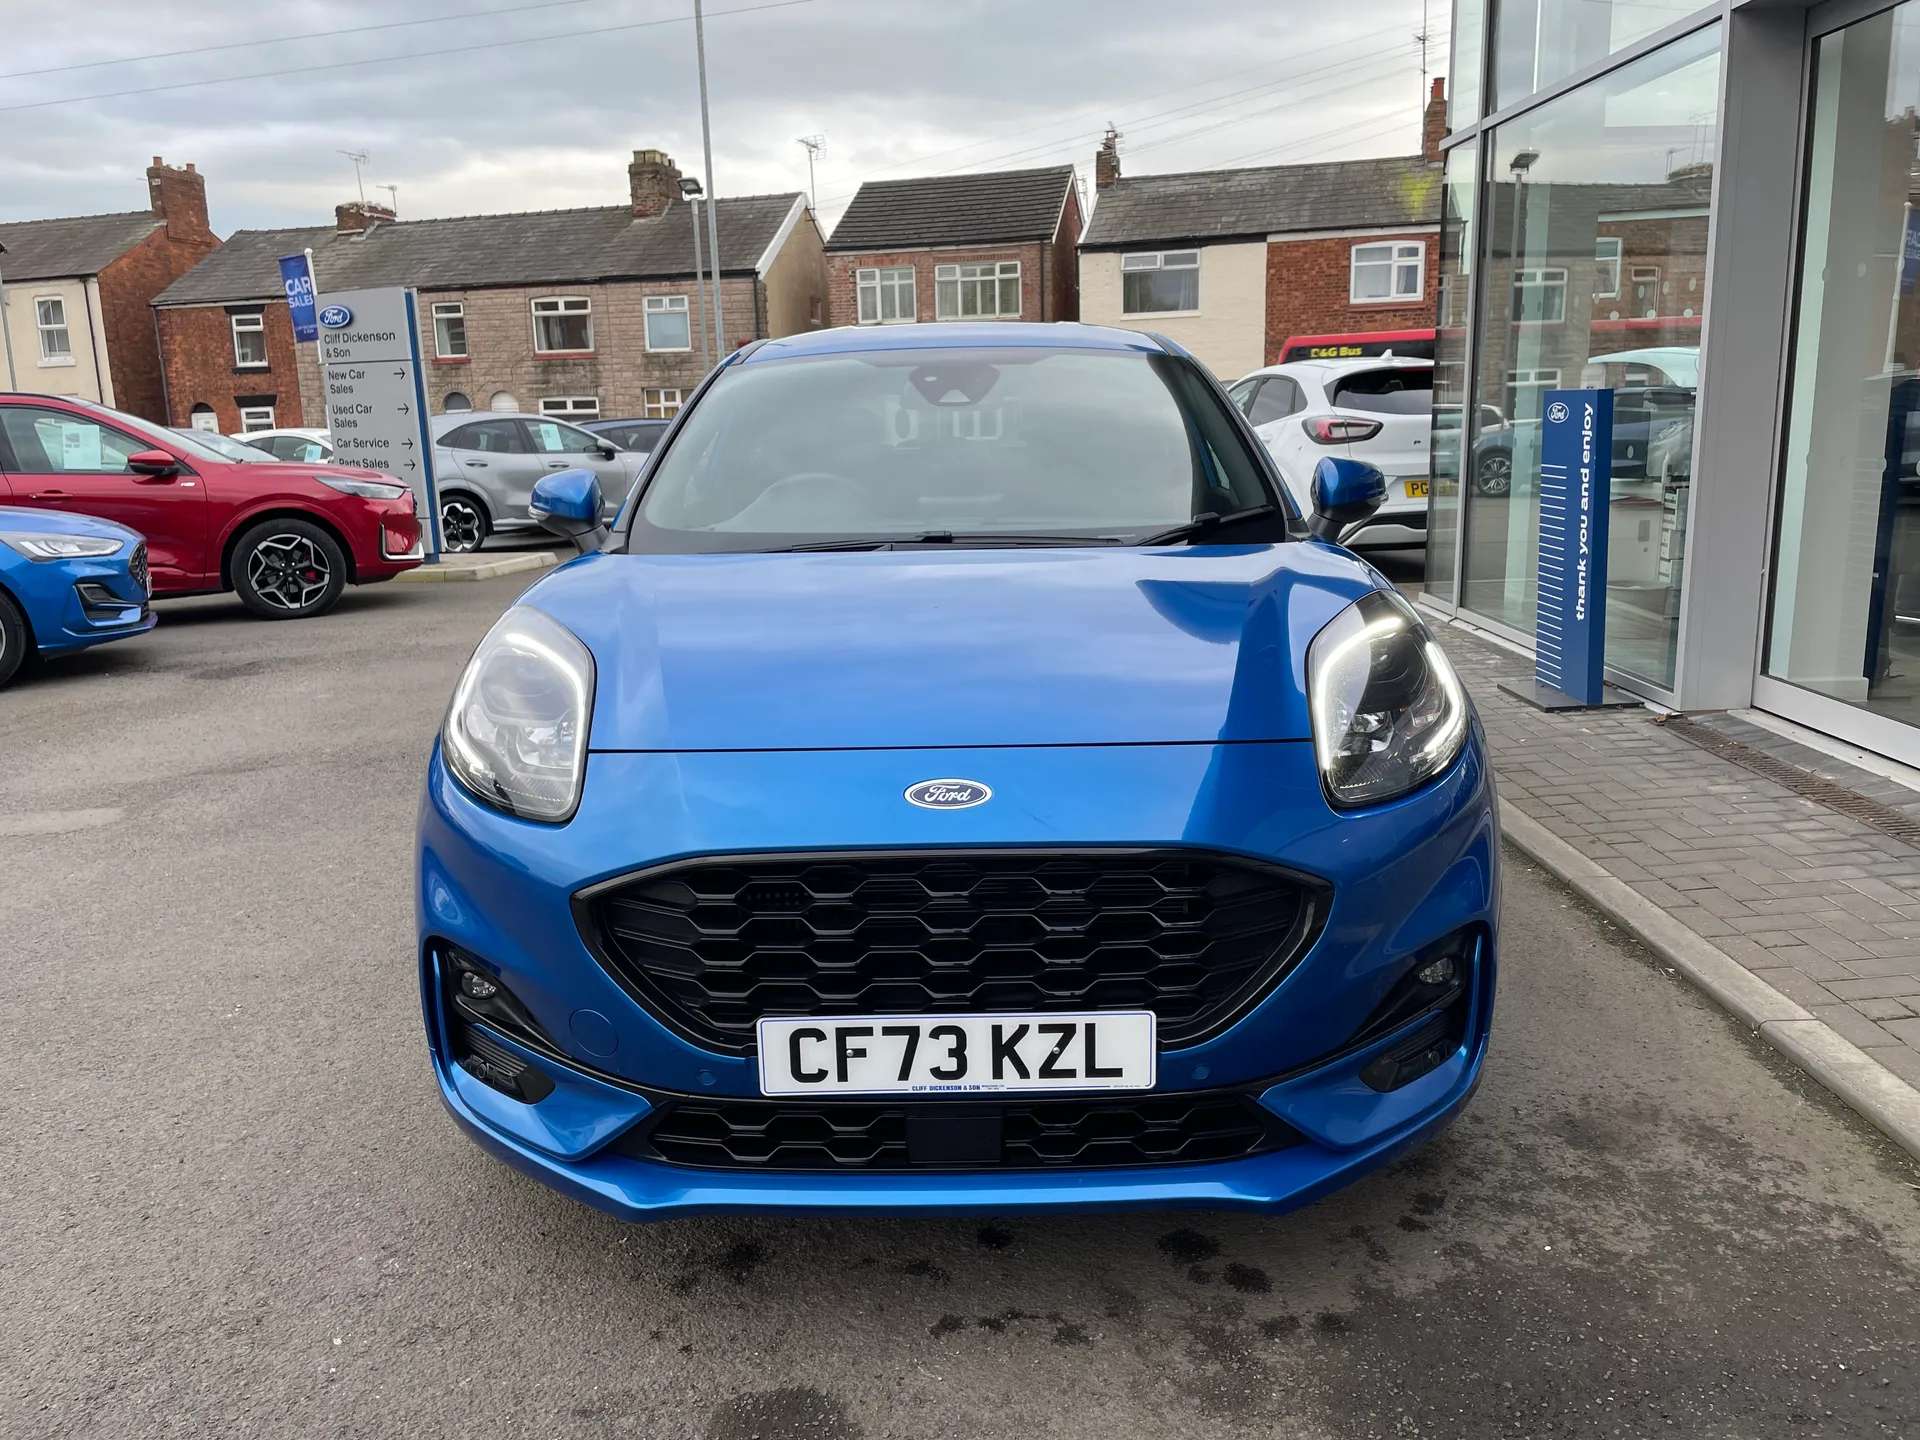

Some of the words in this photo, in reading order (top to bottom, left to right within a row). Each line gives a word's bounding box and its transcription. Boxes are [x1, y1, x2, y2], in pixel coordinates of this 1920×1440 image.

[285, 276, 312, 296] CAR
[288, 294, 314, 308] SALES
[324, 309, 343, 324] Ford
[324, 333, 341, 345] Cliff
[342, 331, 396, 343] Dickenson
[326, 348, 332, 358] &
[333, 347, 351, 358] Son
[1339, 346, 1362, 356] Bus
[328, 370, 347, 381] New
[348, 369, 365, 380] Car
[330, 383, 354, 394] Sales
[332, 404, 354, 415] Used
[355, 403, 373, 414] Car
[334, 417, 358, 428] Sales
[1582, 402, 1593, 464] enjoy
[336, 438, 351, 448] Car
[352, 437, 390, 448] Service
[338, 457, 361, 467] Parts
[362, 457, 390, 469] Sales
[1580, 468, 1590, 511] and
[1578, 515, 1589, 555] you
[1576, 557, 1587, 621] thank
[924, 784, 972, 802] Ford
[788, 1025, 969, 1083] CF73
[990, 1022, 1124, 1080] KZL
